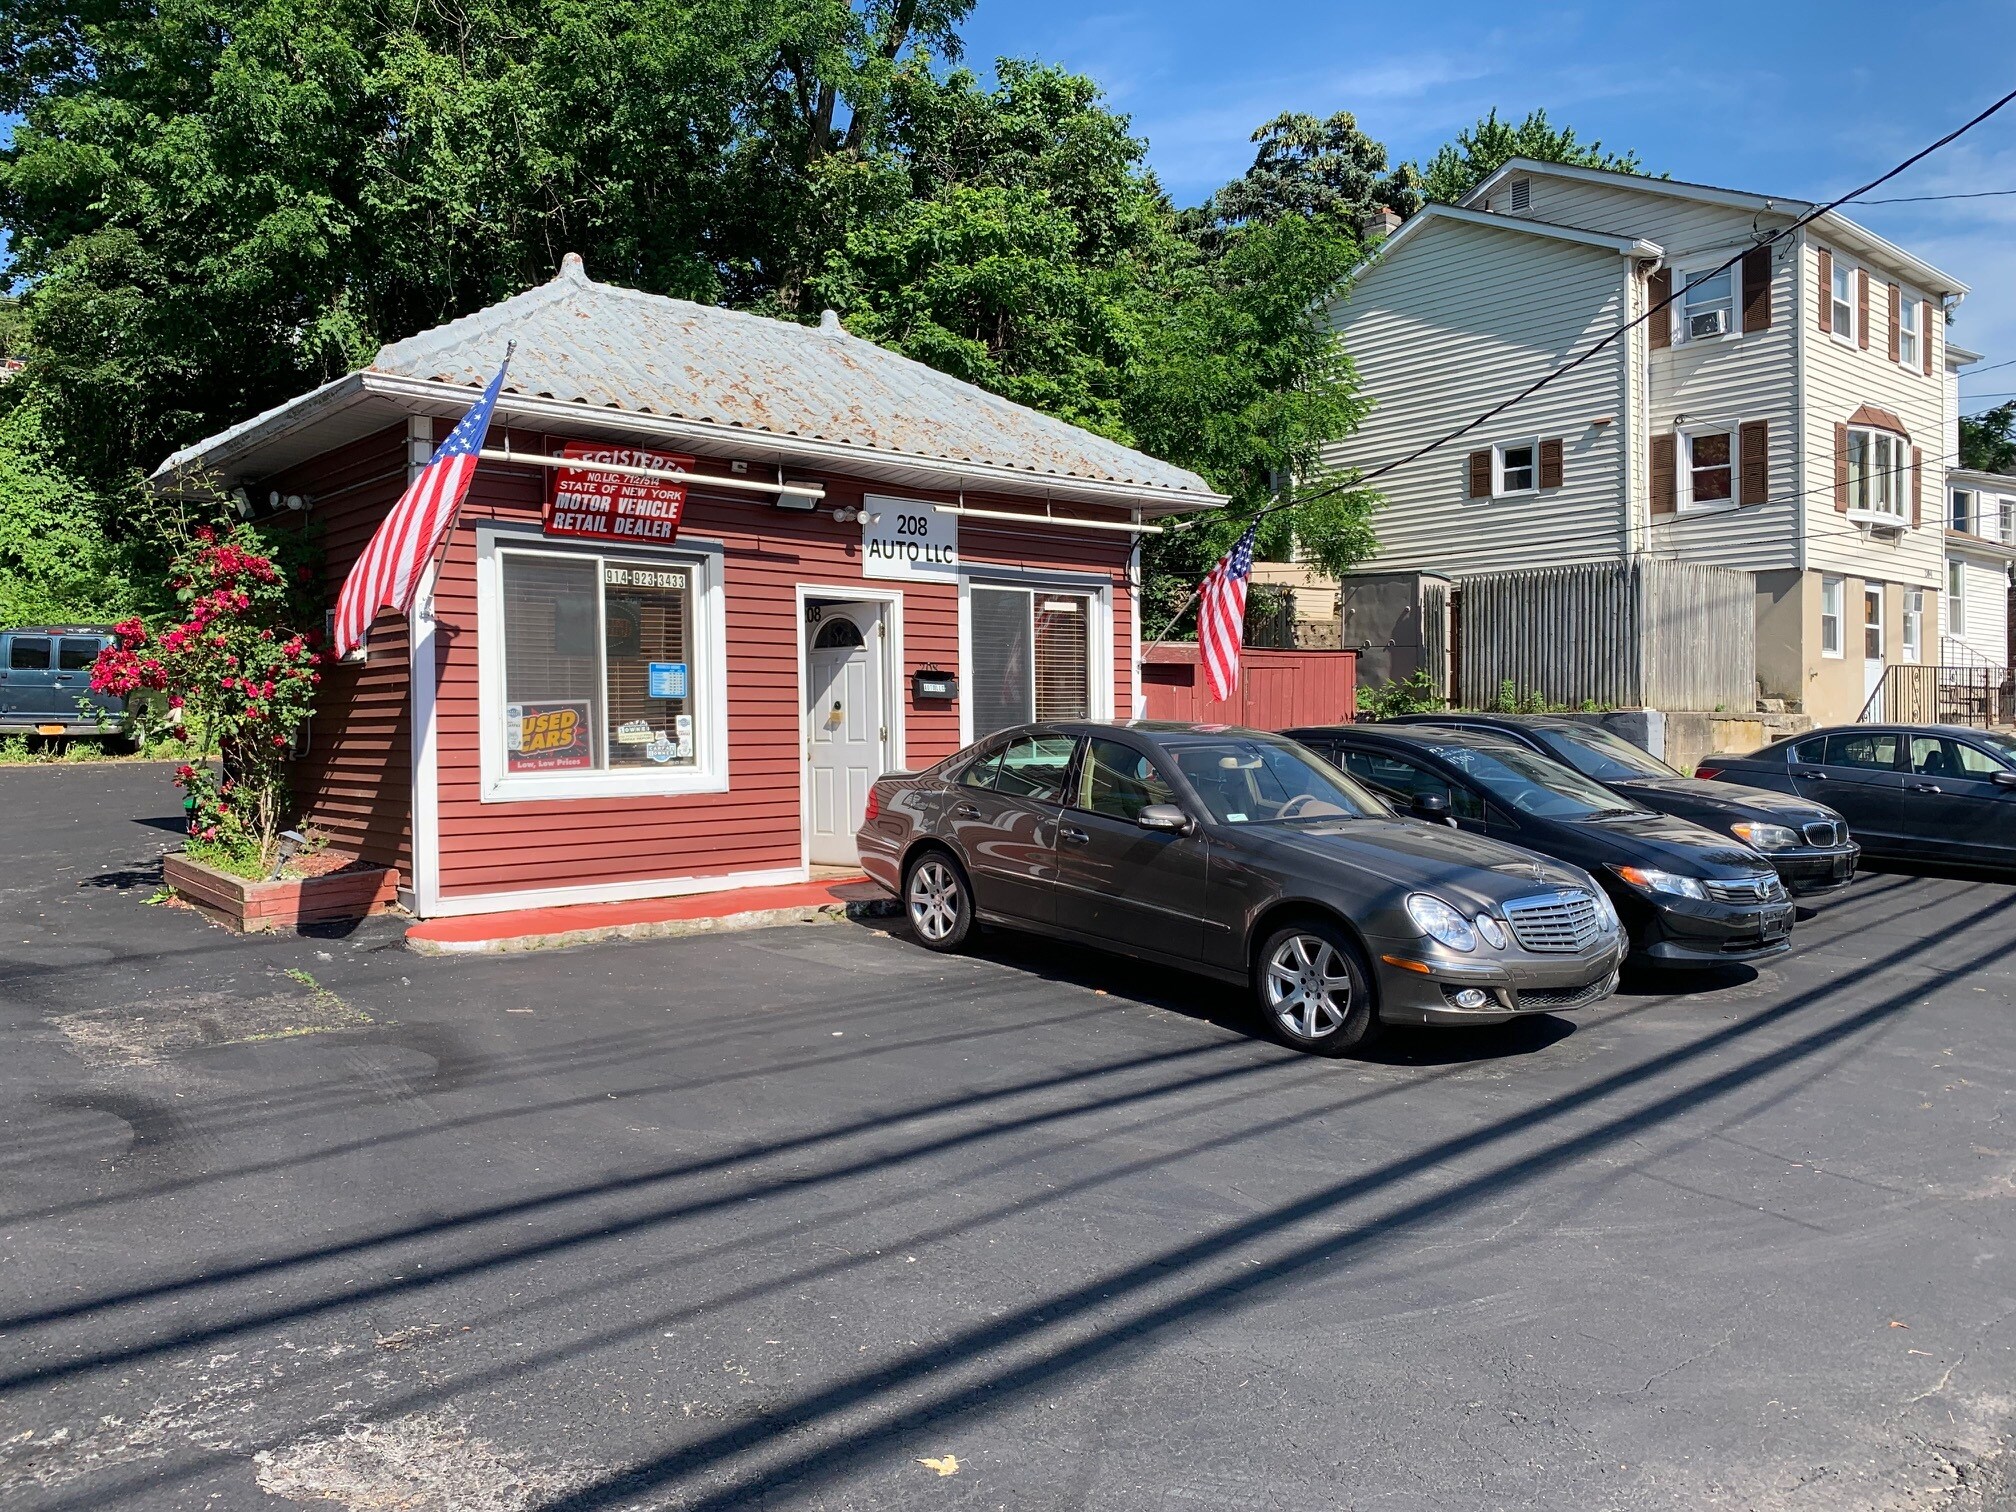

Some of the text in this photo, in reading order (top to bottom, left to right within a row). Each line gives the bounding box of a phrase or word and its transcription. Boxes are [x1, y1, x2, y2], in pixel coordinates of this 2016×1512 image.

[559, 481, 682, 501] STATE OF NEW YORK
[554, 492, 679, 519] MOTOR VEHICLE
[552, 512, 672, 538] RETAIL DEALER
[896, 514, 928, 537] 208
[868, 538, 953, 564] AUTO LLC
[805, 606, 822, 623] 08
[522, 710, 576, 735] USED
[521, 728, 573, 752] CARS
[517, 758, 581, 769] Low, Low Prices
